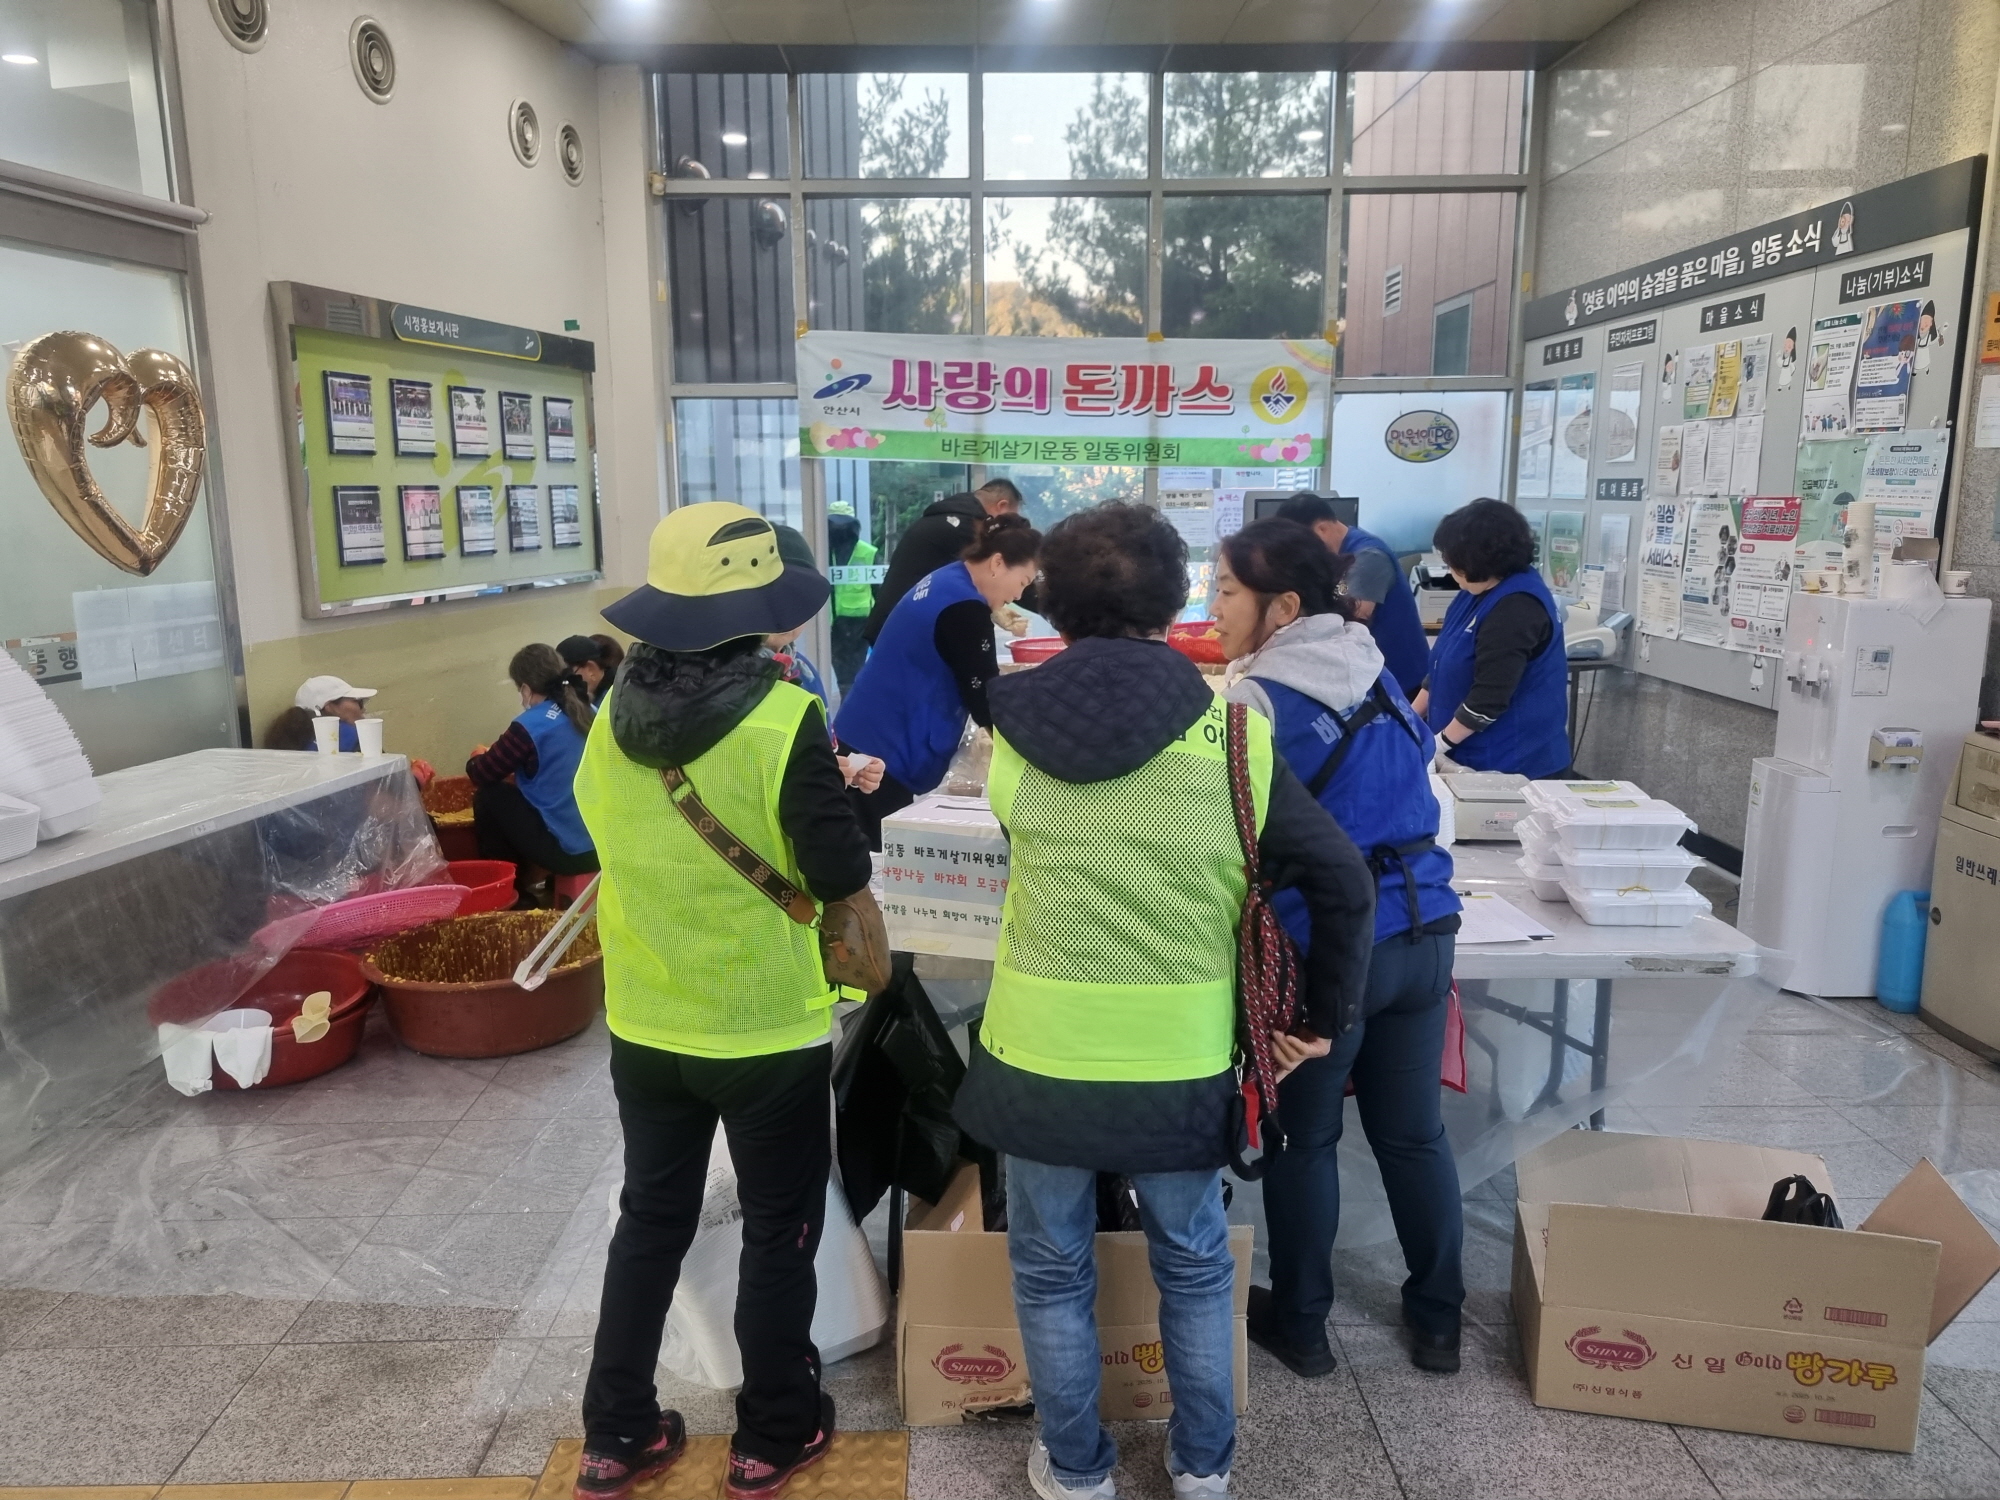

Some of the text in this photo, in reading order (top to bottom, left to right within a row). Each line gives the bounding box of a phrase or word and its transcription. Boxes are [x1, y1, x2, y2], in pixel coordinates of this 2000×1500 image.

[1606, 277, 1640, 308] 이익의
[1641, 264, 1679, 301] 숨결을
[1680, 257, 1708, 290] 품은
[1751, 232, 1783, 270] 일동
[1784, 220, 1823, 259] 소식
[1845, 260, 1925, 297] 나눔(기부)소식
[403, 315, 460, 339] 시정홍보게시판
[1609, 323, 1655, 348] 주민자치프로그램
[881, 357, 1235, 417] 사랑의 돈까스
[822, 404, 861, 417] 안산시
[1390, 427, 1454, 446] 민원인PC
[941, 438, 1181, 464] 바르게살기운동 일동위원회
[1656, 504, 1676, 524] 일상
[1781, 509, 1798, 523] 노인
[1654, 525, 1674, 545] 돌봄
[1646, 547, 1673, 568] 서비스
[884, 841, 1008, 868] 일동 바르게살기위원회
[882, 867, 925, 884] 사랑나눔
[934, 871, 968, 887] 바자회
[1955, 855, 2000, 886] 일반쓰레
[883, 903, 1003, 926] 사랑을 나누면 희망이 자랍니
[1582, 1344, 1621, 1357] SHIN
[948, 1361, 984, 1372] SHIN
[1734, 1350, 1783, 1371] Gold
[1785, 1350, 1898, 1391] 빵가루
